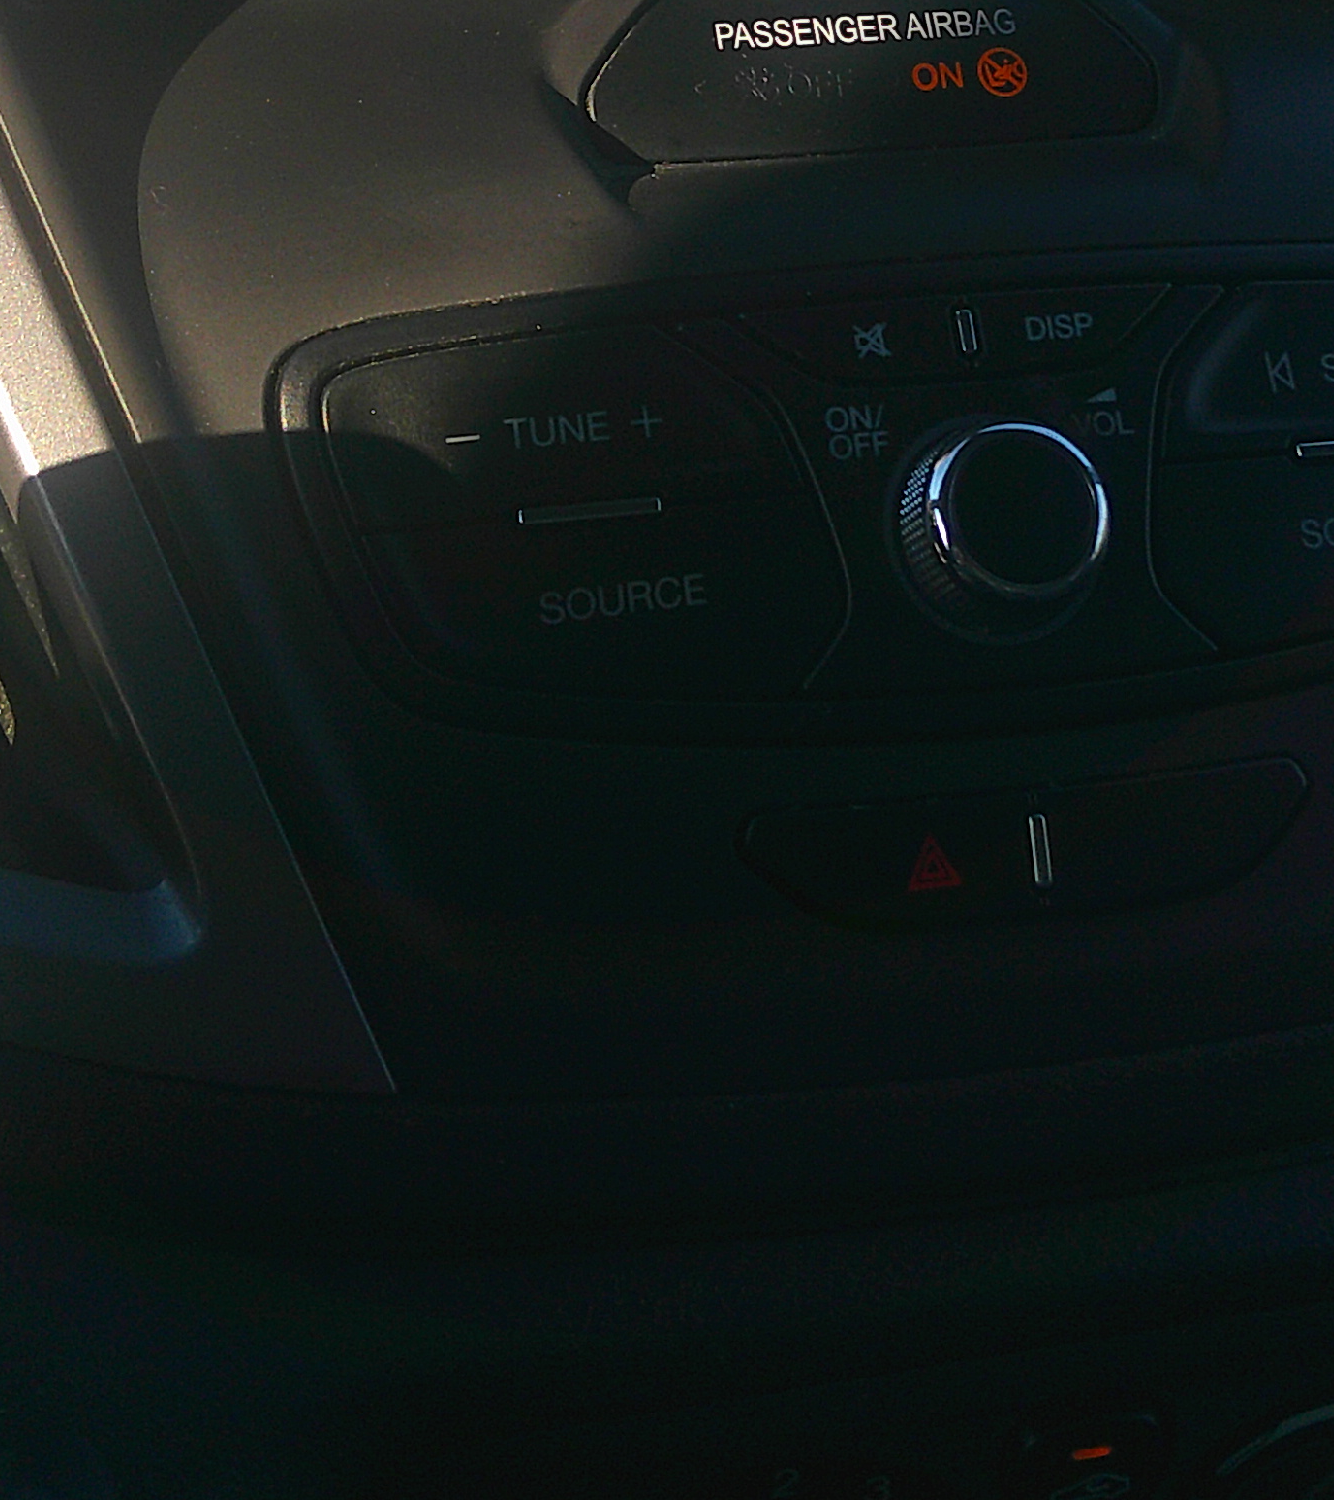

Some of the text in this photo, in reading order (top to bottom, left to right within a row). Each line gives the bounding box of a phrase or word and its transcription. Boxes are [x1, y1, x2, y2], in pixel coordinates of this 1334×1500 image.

[713, 7, 1017, 51] PASSENGER AIRBAG
[909, 60, 965, 92] ON
[1022, 309, 1096, 343] DISP
[501, 409, 611, 450] TUNE
[823, 402, 886, 434] ON/
[1069, 408, 1136, 439] VOL
[827, 430, 890, 462] OFF
[538, 570, 709, 627] SOURCE
